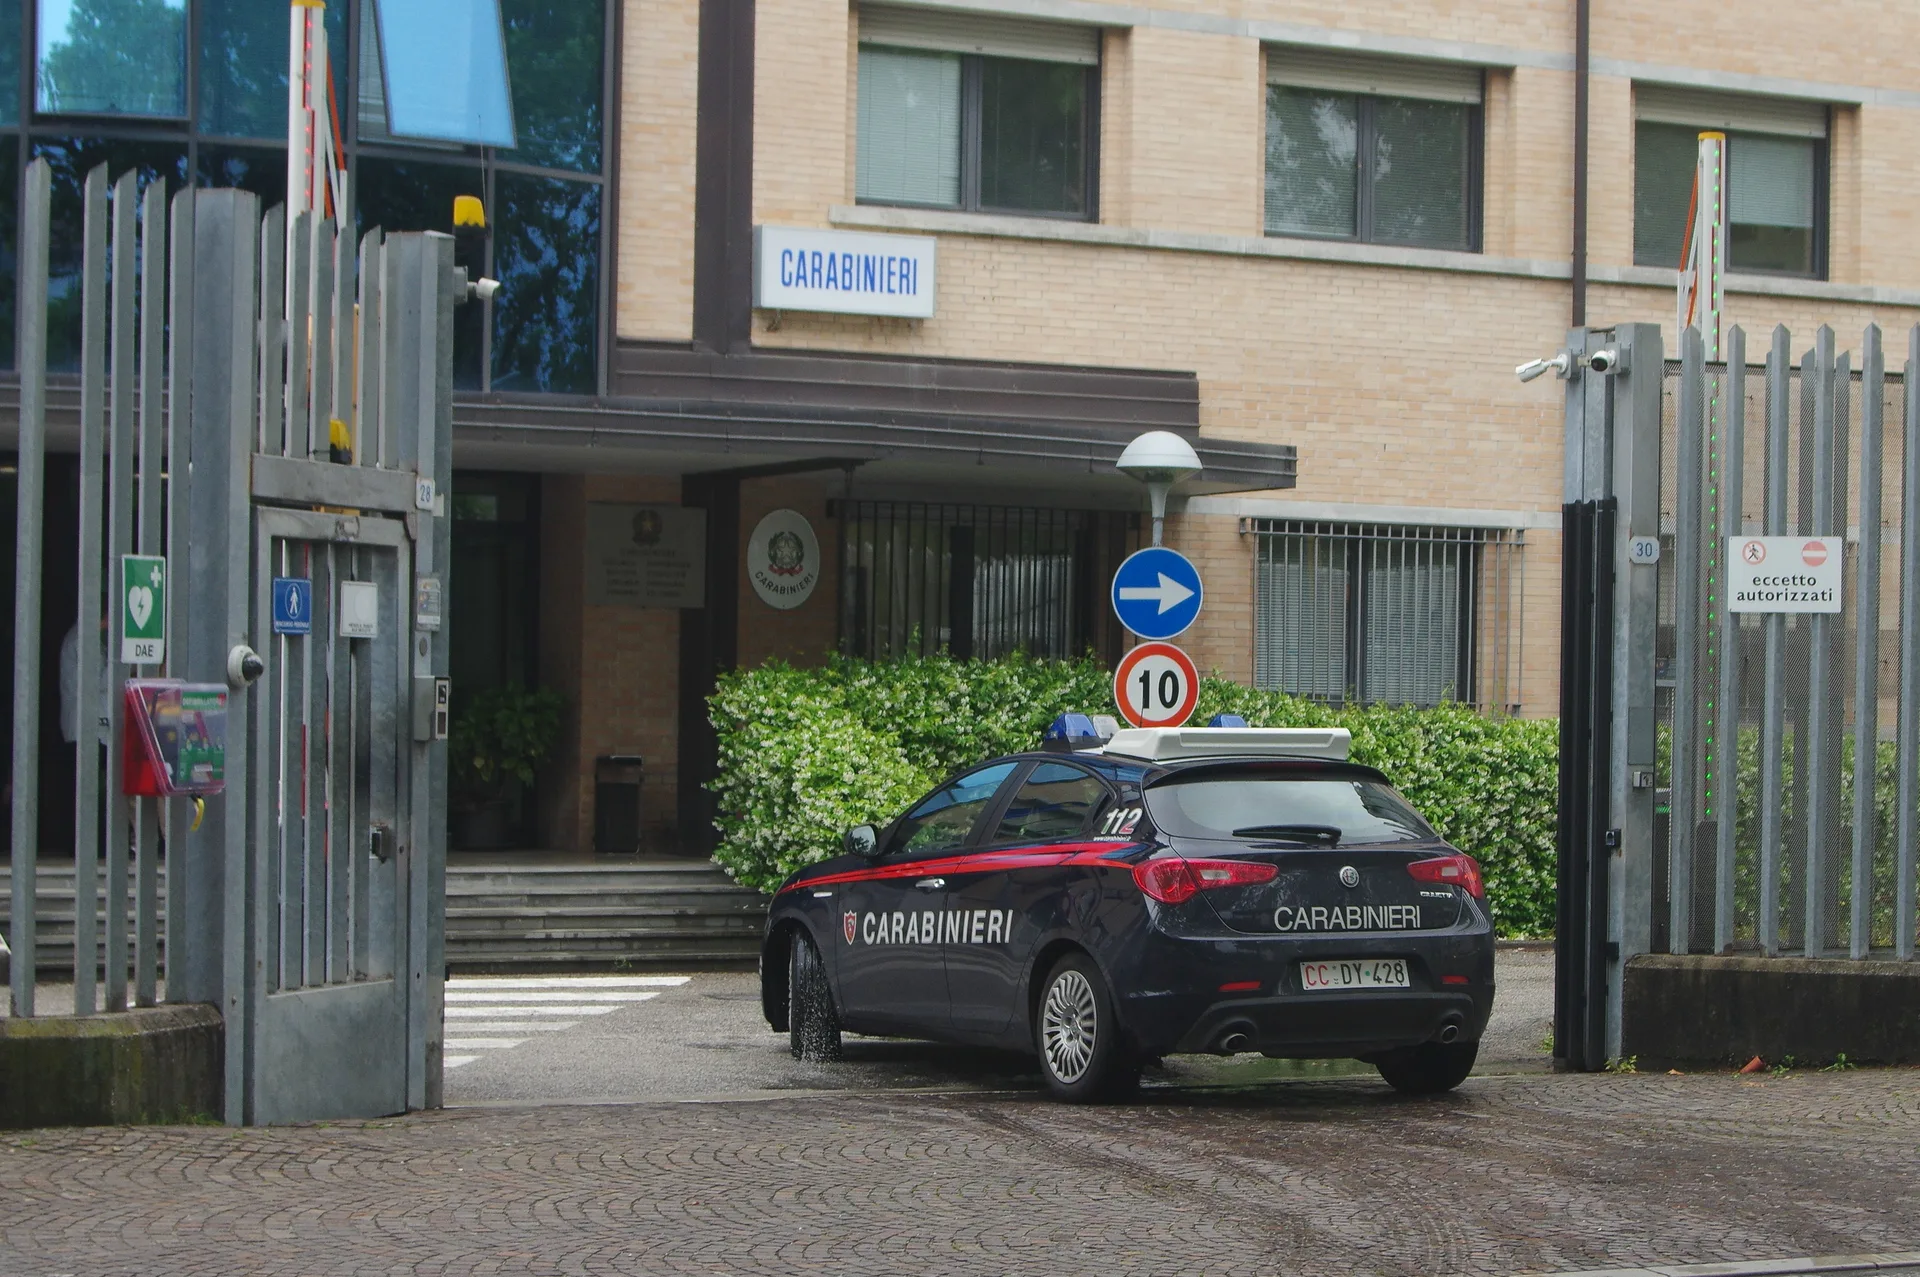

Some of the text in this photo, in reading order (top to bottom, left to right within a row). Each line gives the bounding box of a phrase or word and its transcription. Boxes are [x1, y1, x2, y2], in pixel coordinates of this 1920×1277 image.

[781, 248, 917, 296] CARABINIERI
[420, 485, 431, 502] 28
[1636, 542, 1653, 557] 30
[755, 571, 814, 595] CARABINIERI
[1752, 574, 1816, 586] eccetto
[1737, 588, 1832, 602] autorizzati
[135, 645, 153, 657] DAE
[1139, 670, 1179, 709] 10
[1101, 808, 1143, 834] 112
[863, 909, 1013, 945] CARABINIERI
[1274, 905, 1420, 930] CARABINIERI
[1305, 962, 1405, 986] CC DY 428
